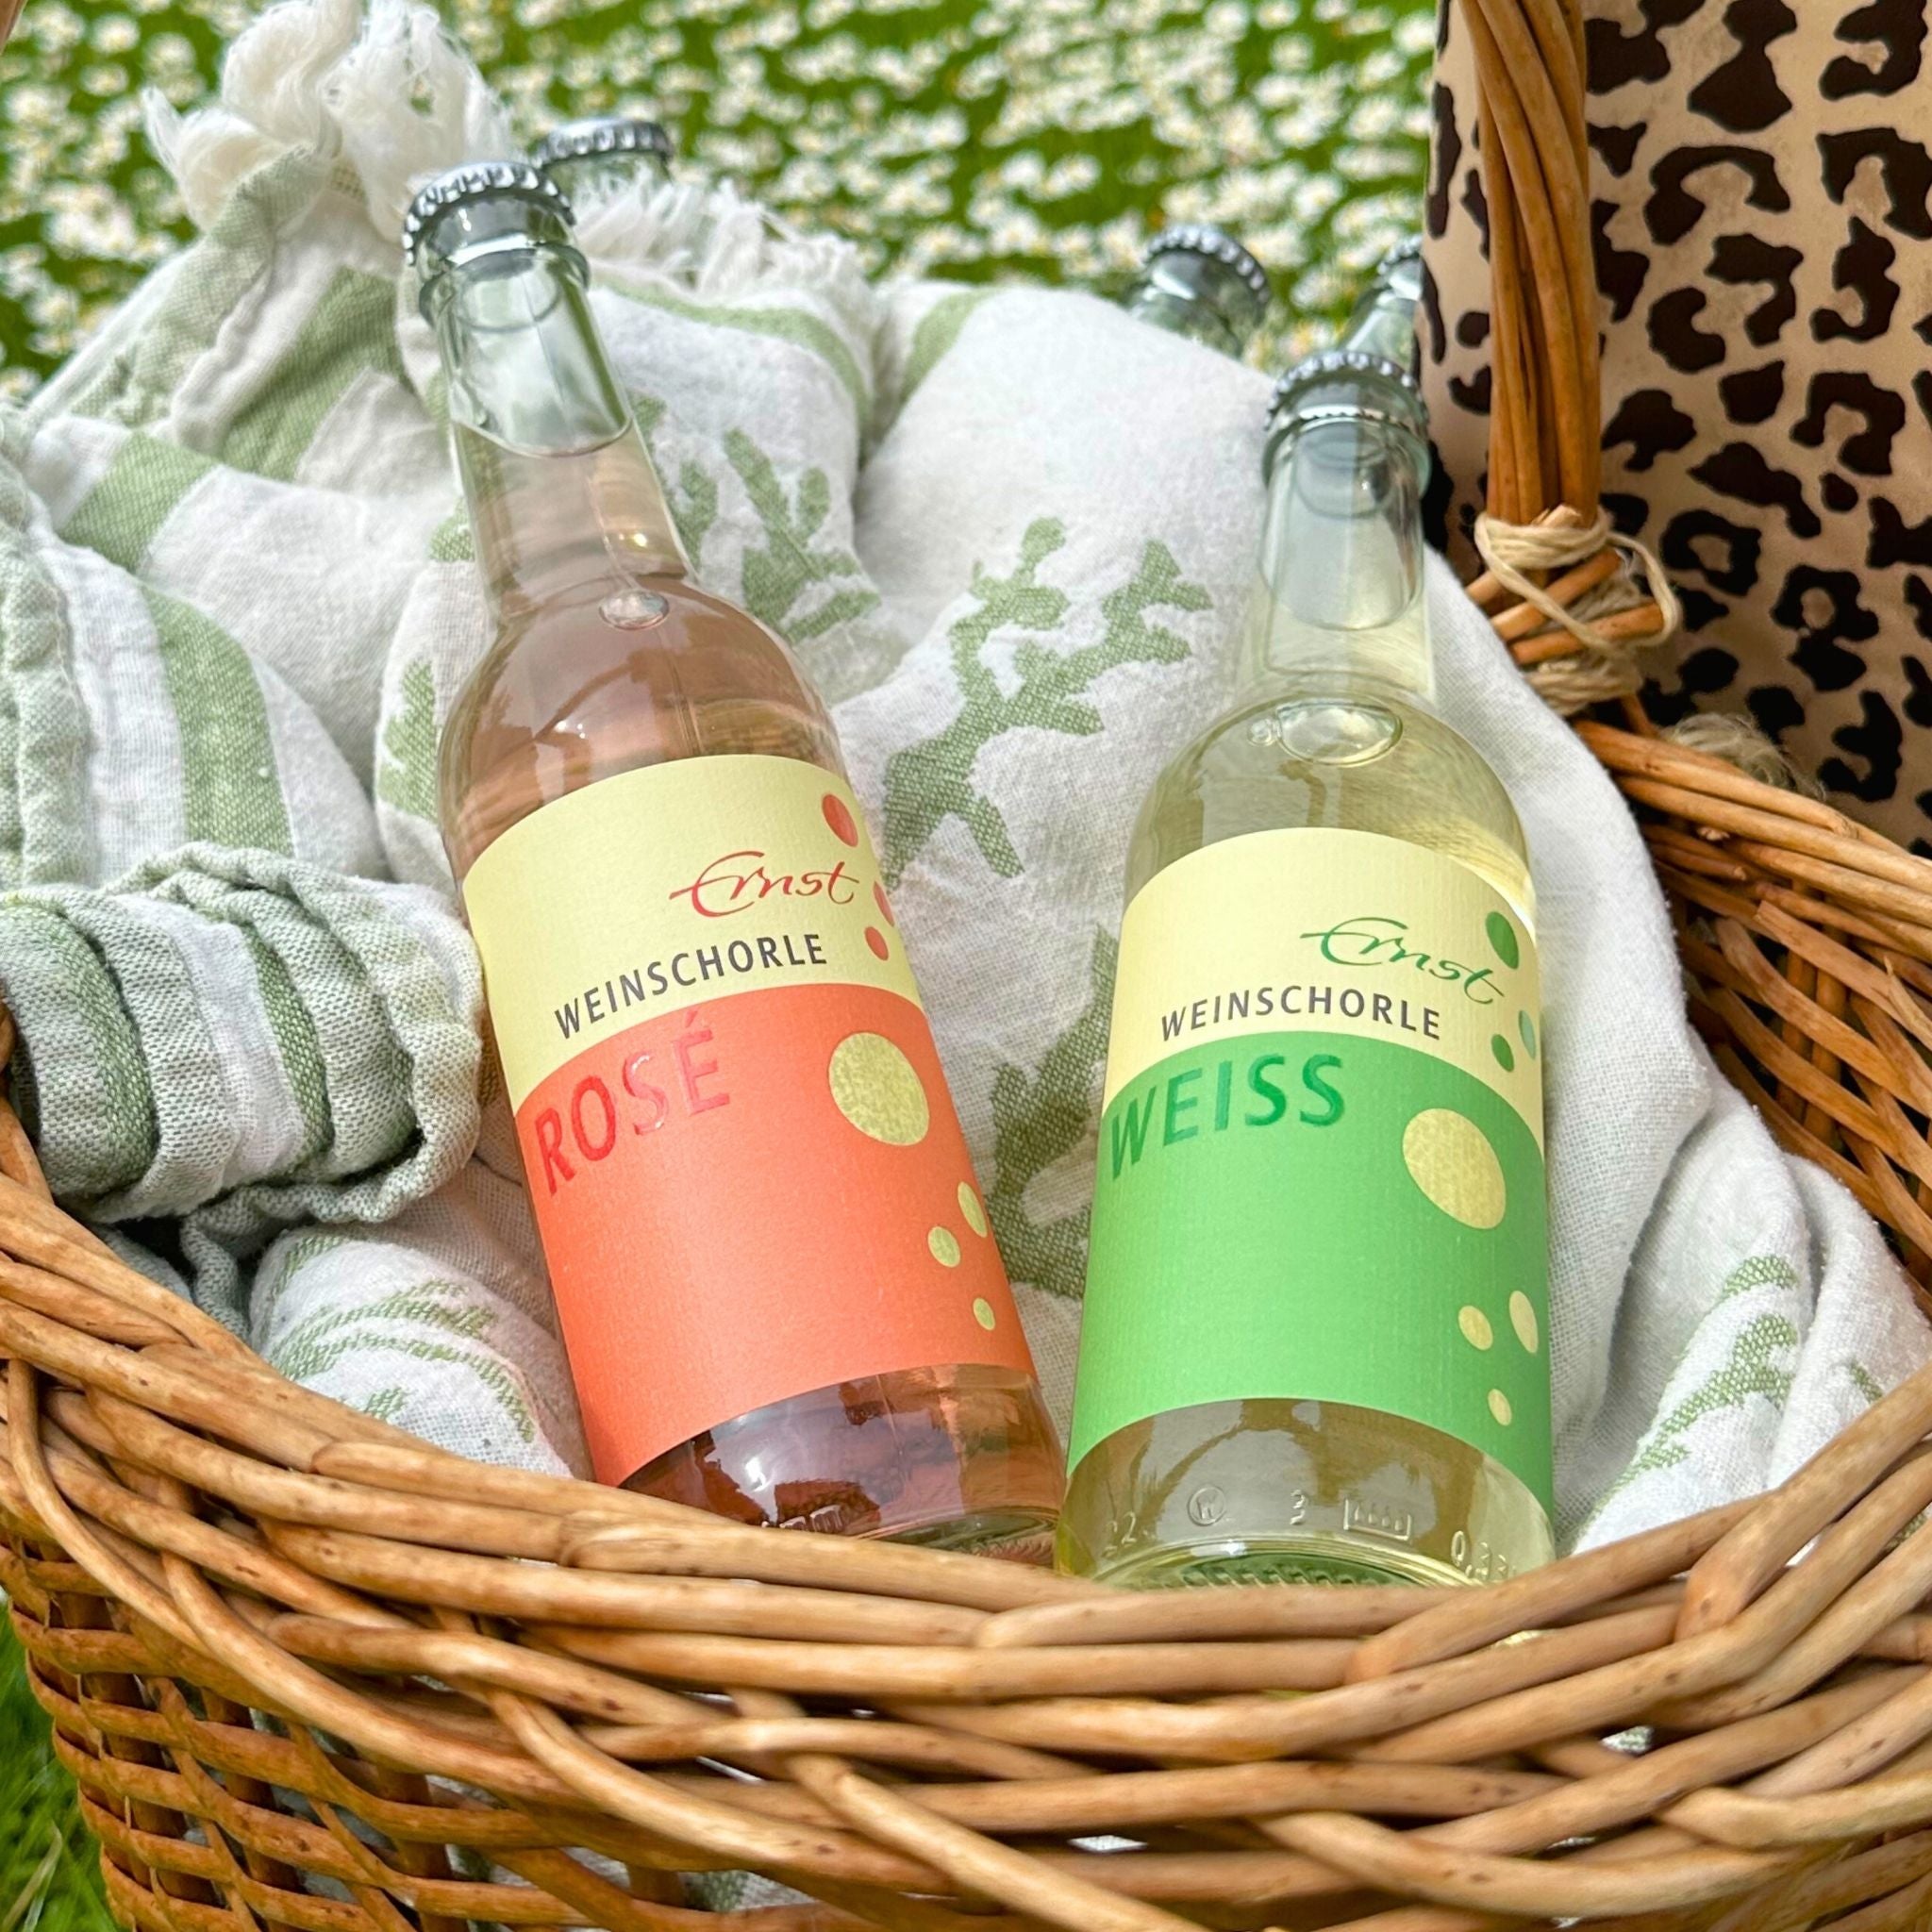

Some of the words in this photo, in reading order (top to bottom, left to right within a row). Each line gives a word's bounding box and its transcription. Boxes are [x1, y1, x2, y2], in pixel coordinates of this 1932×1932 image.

[669, 850, 860, 918] Ernst
[554, 933, 827, 1040] WEINSCHORLE
[1300, 916, 1506, 1005] Ernst
[1160, 985, 1441, 1041] WEINSCHORLE
[534, 1010, 730, 1196] ROSÉ
[1110, 1054, 1346, 1180] WEISS
